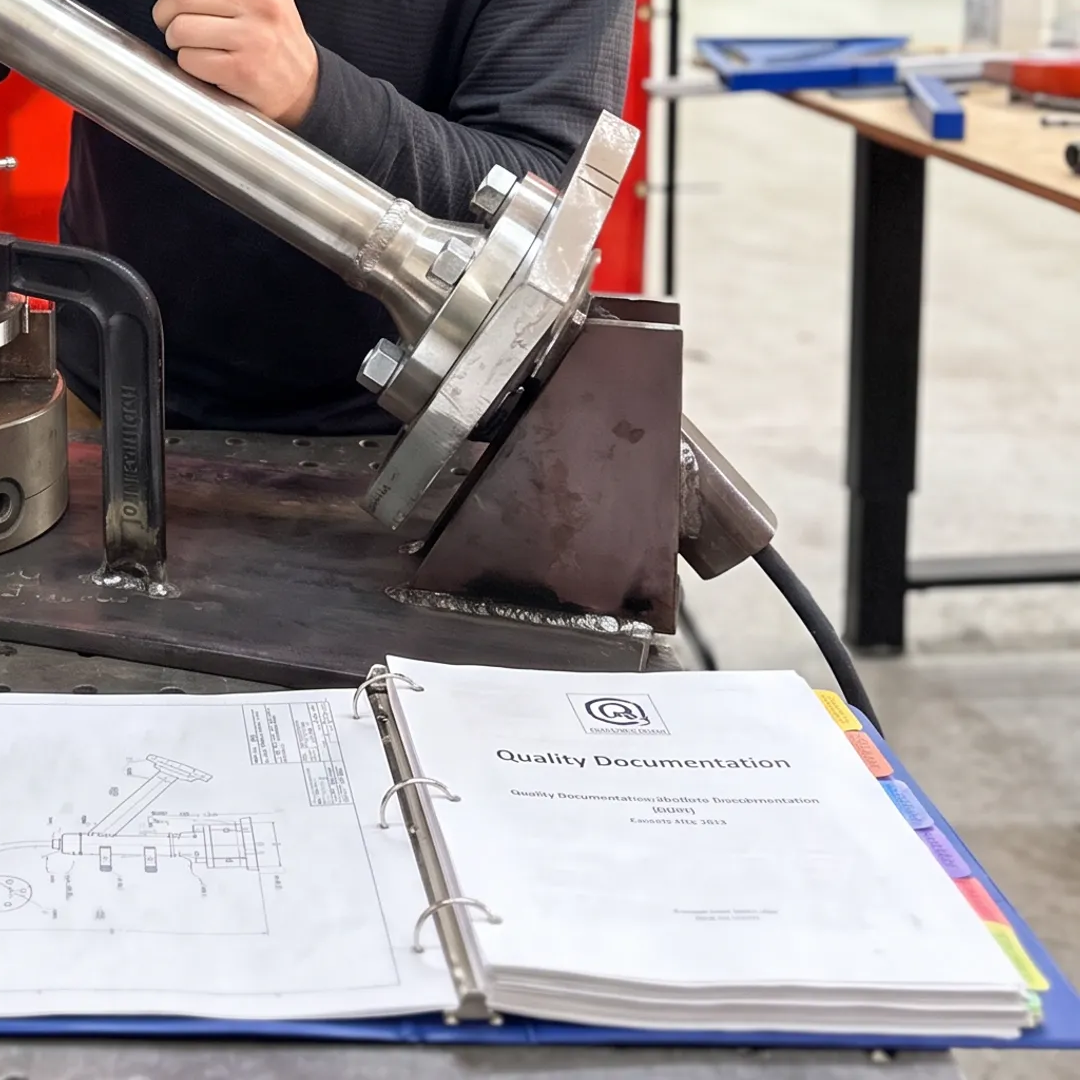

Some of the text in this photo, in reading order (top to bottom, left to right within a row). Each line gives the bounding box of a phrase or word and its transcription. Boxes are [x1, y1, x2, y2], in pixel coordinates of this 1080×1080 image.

[496, 748, 792, 769] Quality Documentation
[510, 788, 555, 800] Quality
